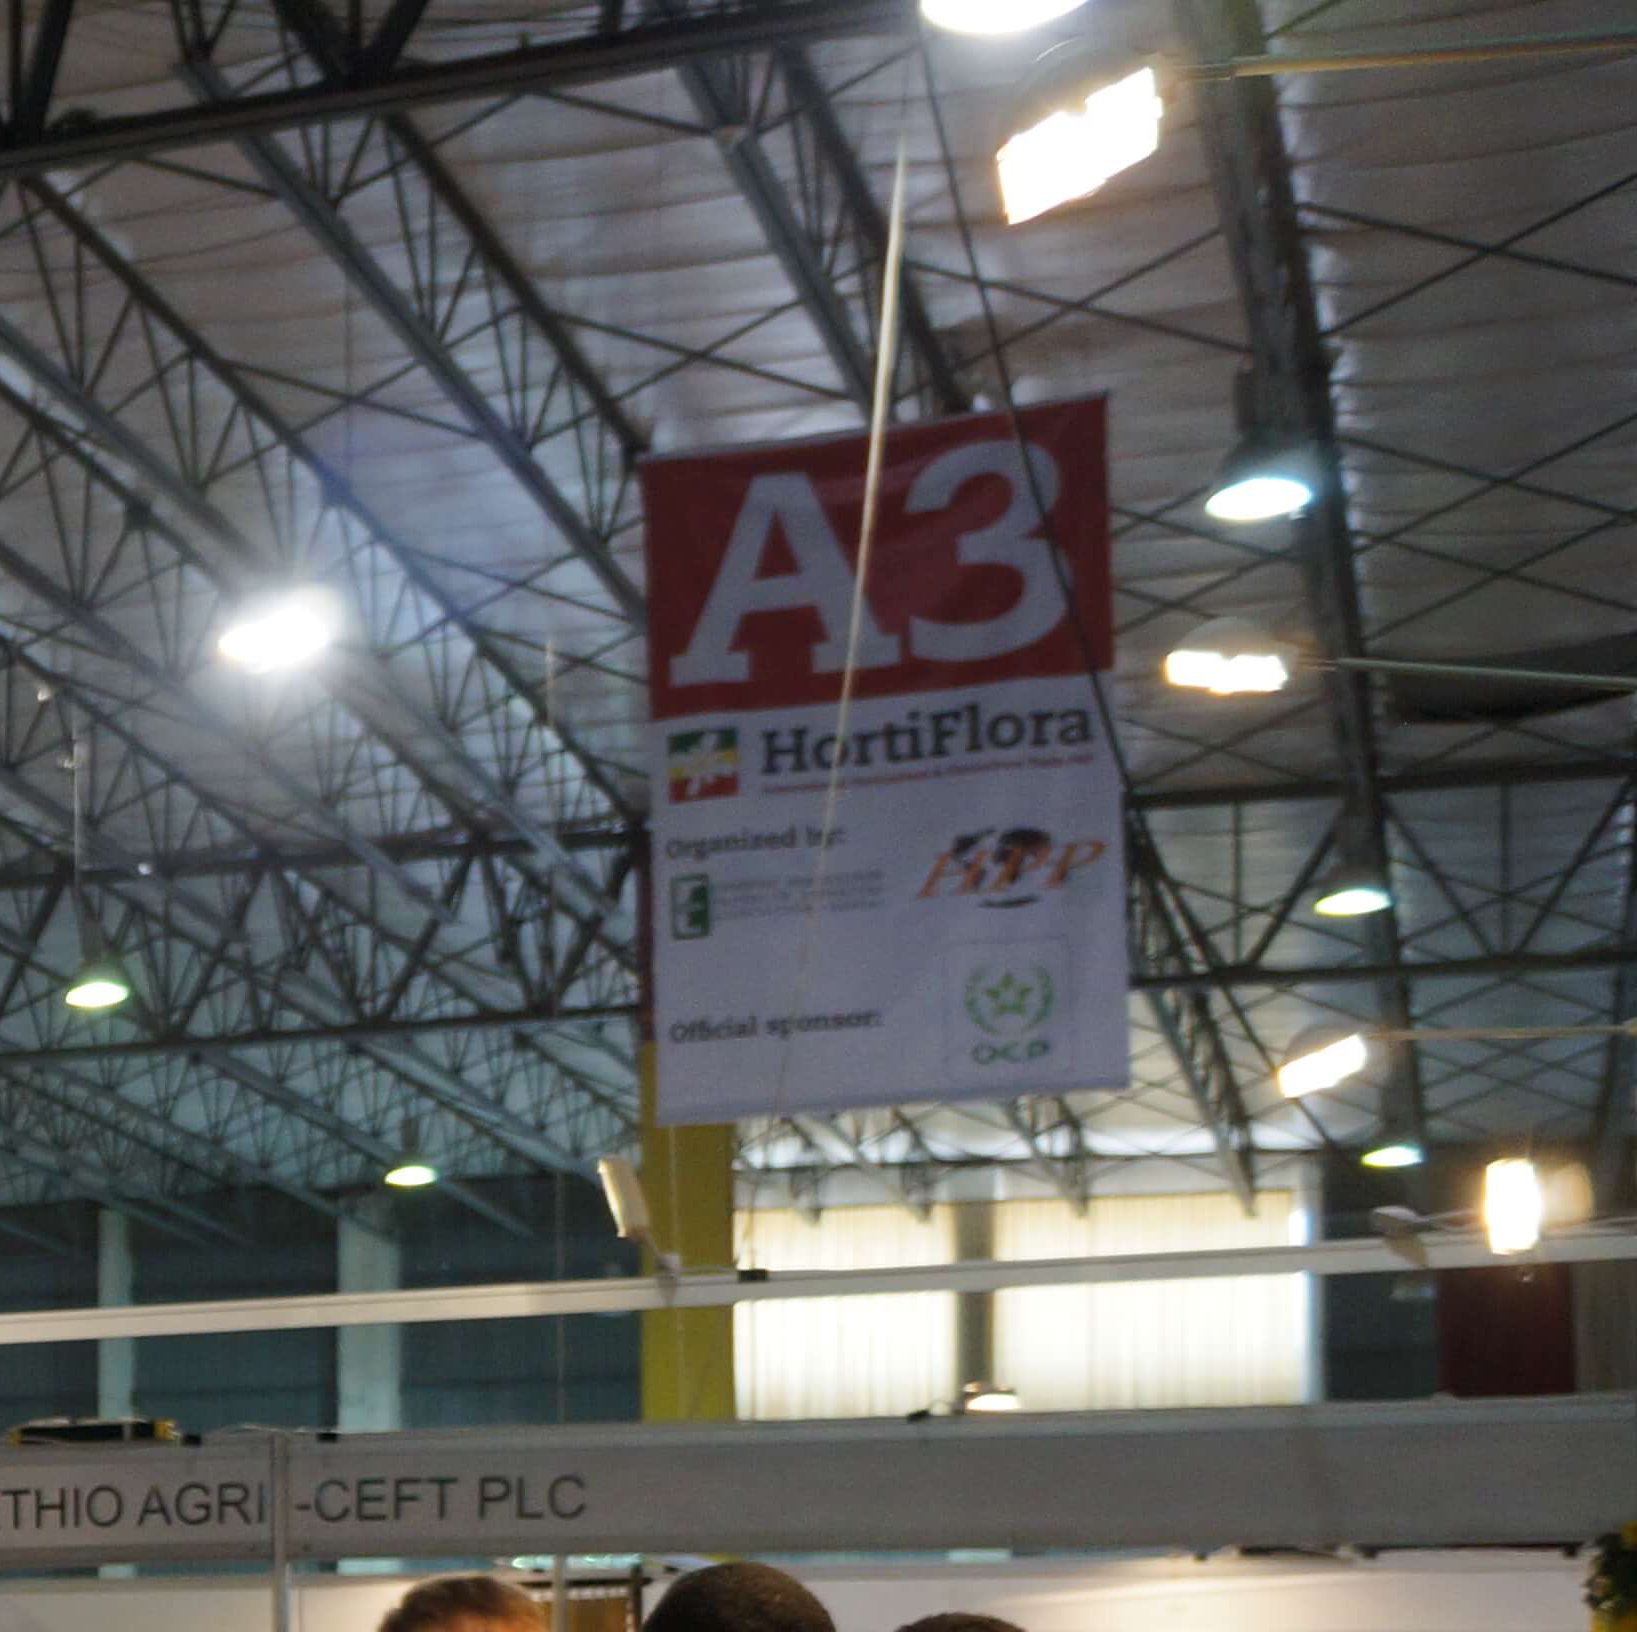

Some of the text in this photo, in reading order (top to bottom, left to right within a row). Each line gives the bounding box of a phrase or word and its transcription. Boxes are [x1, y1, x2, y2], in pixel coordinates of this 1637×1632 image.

[669, 438, 1077, 688] A3
[760, 704, 1095, 777] HortiFlora
[666, 827, 797, 860] Organized
[669, 1016, 758, 1044] Official
[138, 1481, 265, 1528] AGRI
[478, 1473, 588, 1521] PLC
